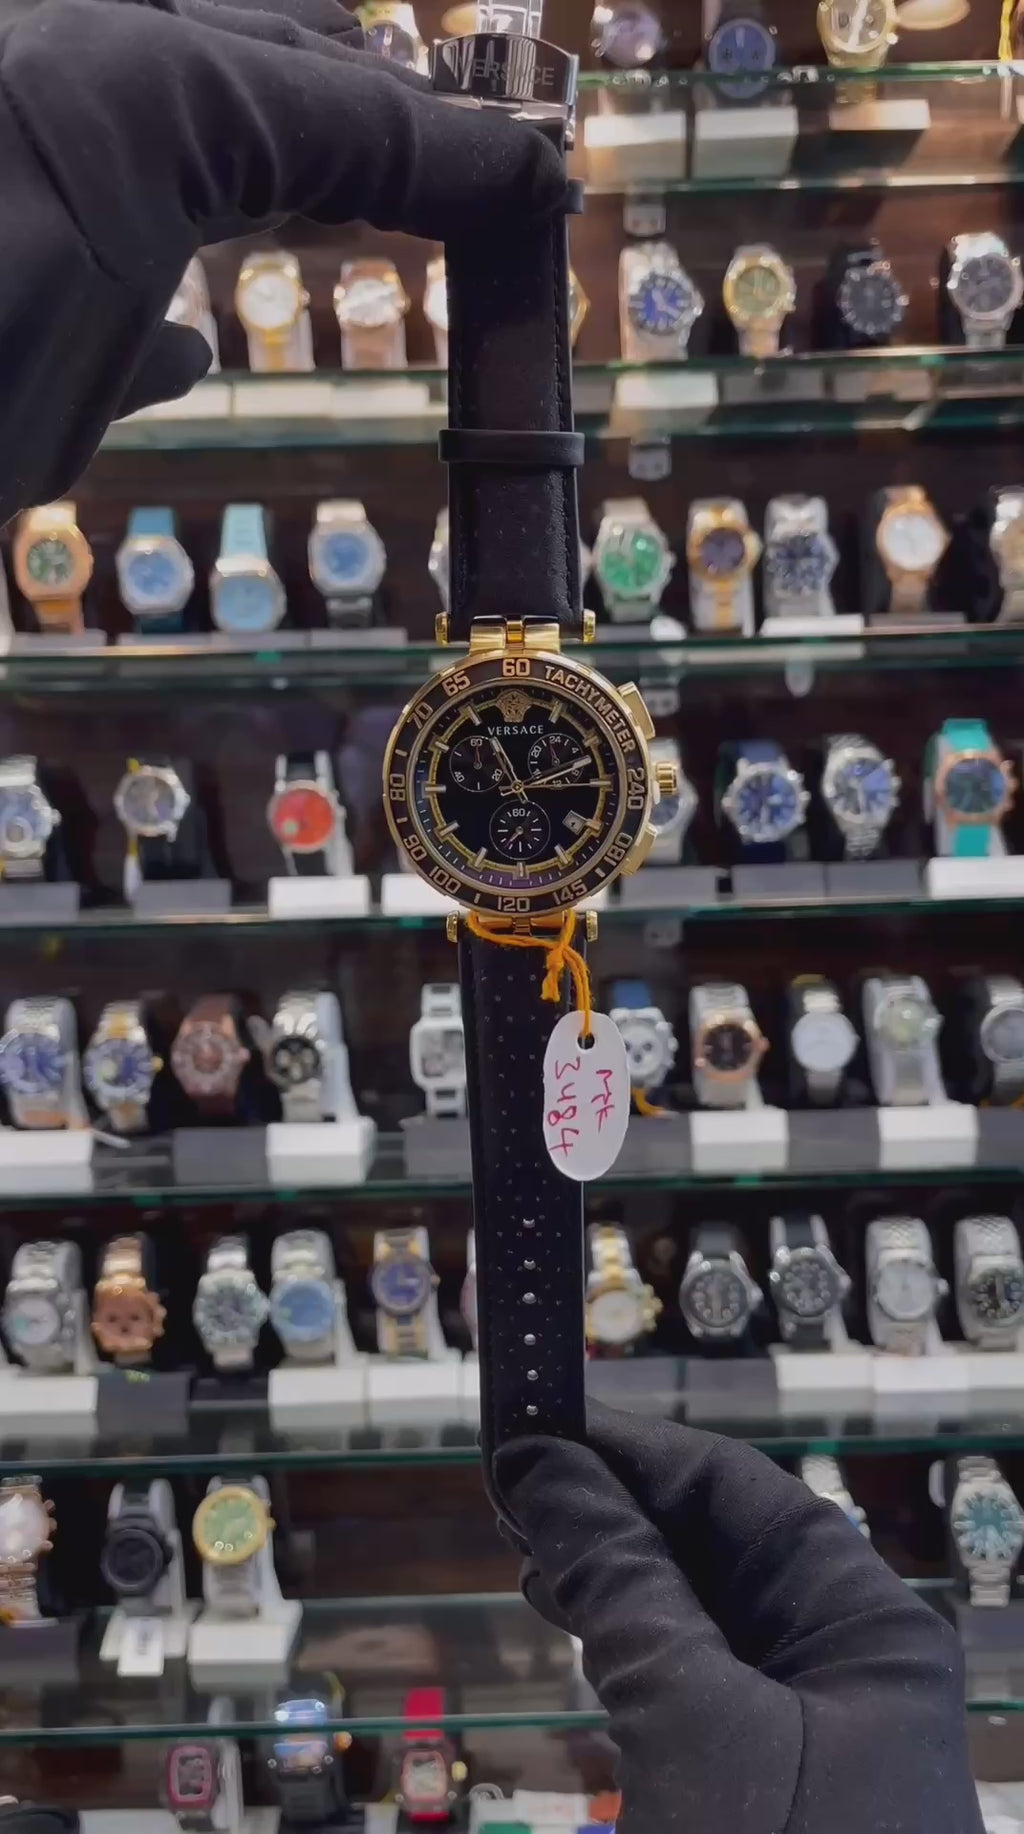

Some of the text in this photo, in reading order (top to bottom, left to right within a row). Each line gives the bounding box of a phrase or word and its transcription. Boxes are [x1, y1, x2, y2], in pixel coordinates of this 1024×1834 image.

[460, 56, 555, 86] VERSCE
[502, 658, 531, 677] 60
[442, 671, 471, 697] 65
[407, 702, 433, 726] 70
[545, 665, 636, 753] TACHYMETER
[470, 738, 483, 747] 60
[487, 725, 543, 736] VERSACE
[549, 735, 562, 744] 24
[530, 746, 542, 758] 20
[389, 774, 405, 801] 80
[454, 771, 465, 783] 40
[491, 768, 503, 782] 20
[627, 768, 644, 810] 240
[512, 808, 526, 817] 60
[404, 835, 427, 862] 90
[603, 832, 634, 867] 180
[429, 866, 462, 895] 100
[552, 879, 588, 906] 145
[497, 896, 531, 912] 120
[547, 1056, 581, 1157] 3484
